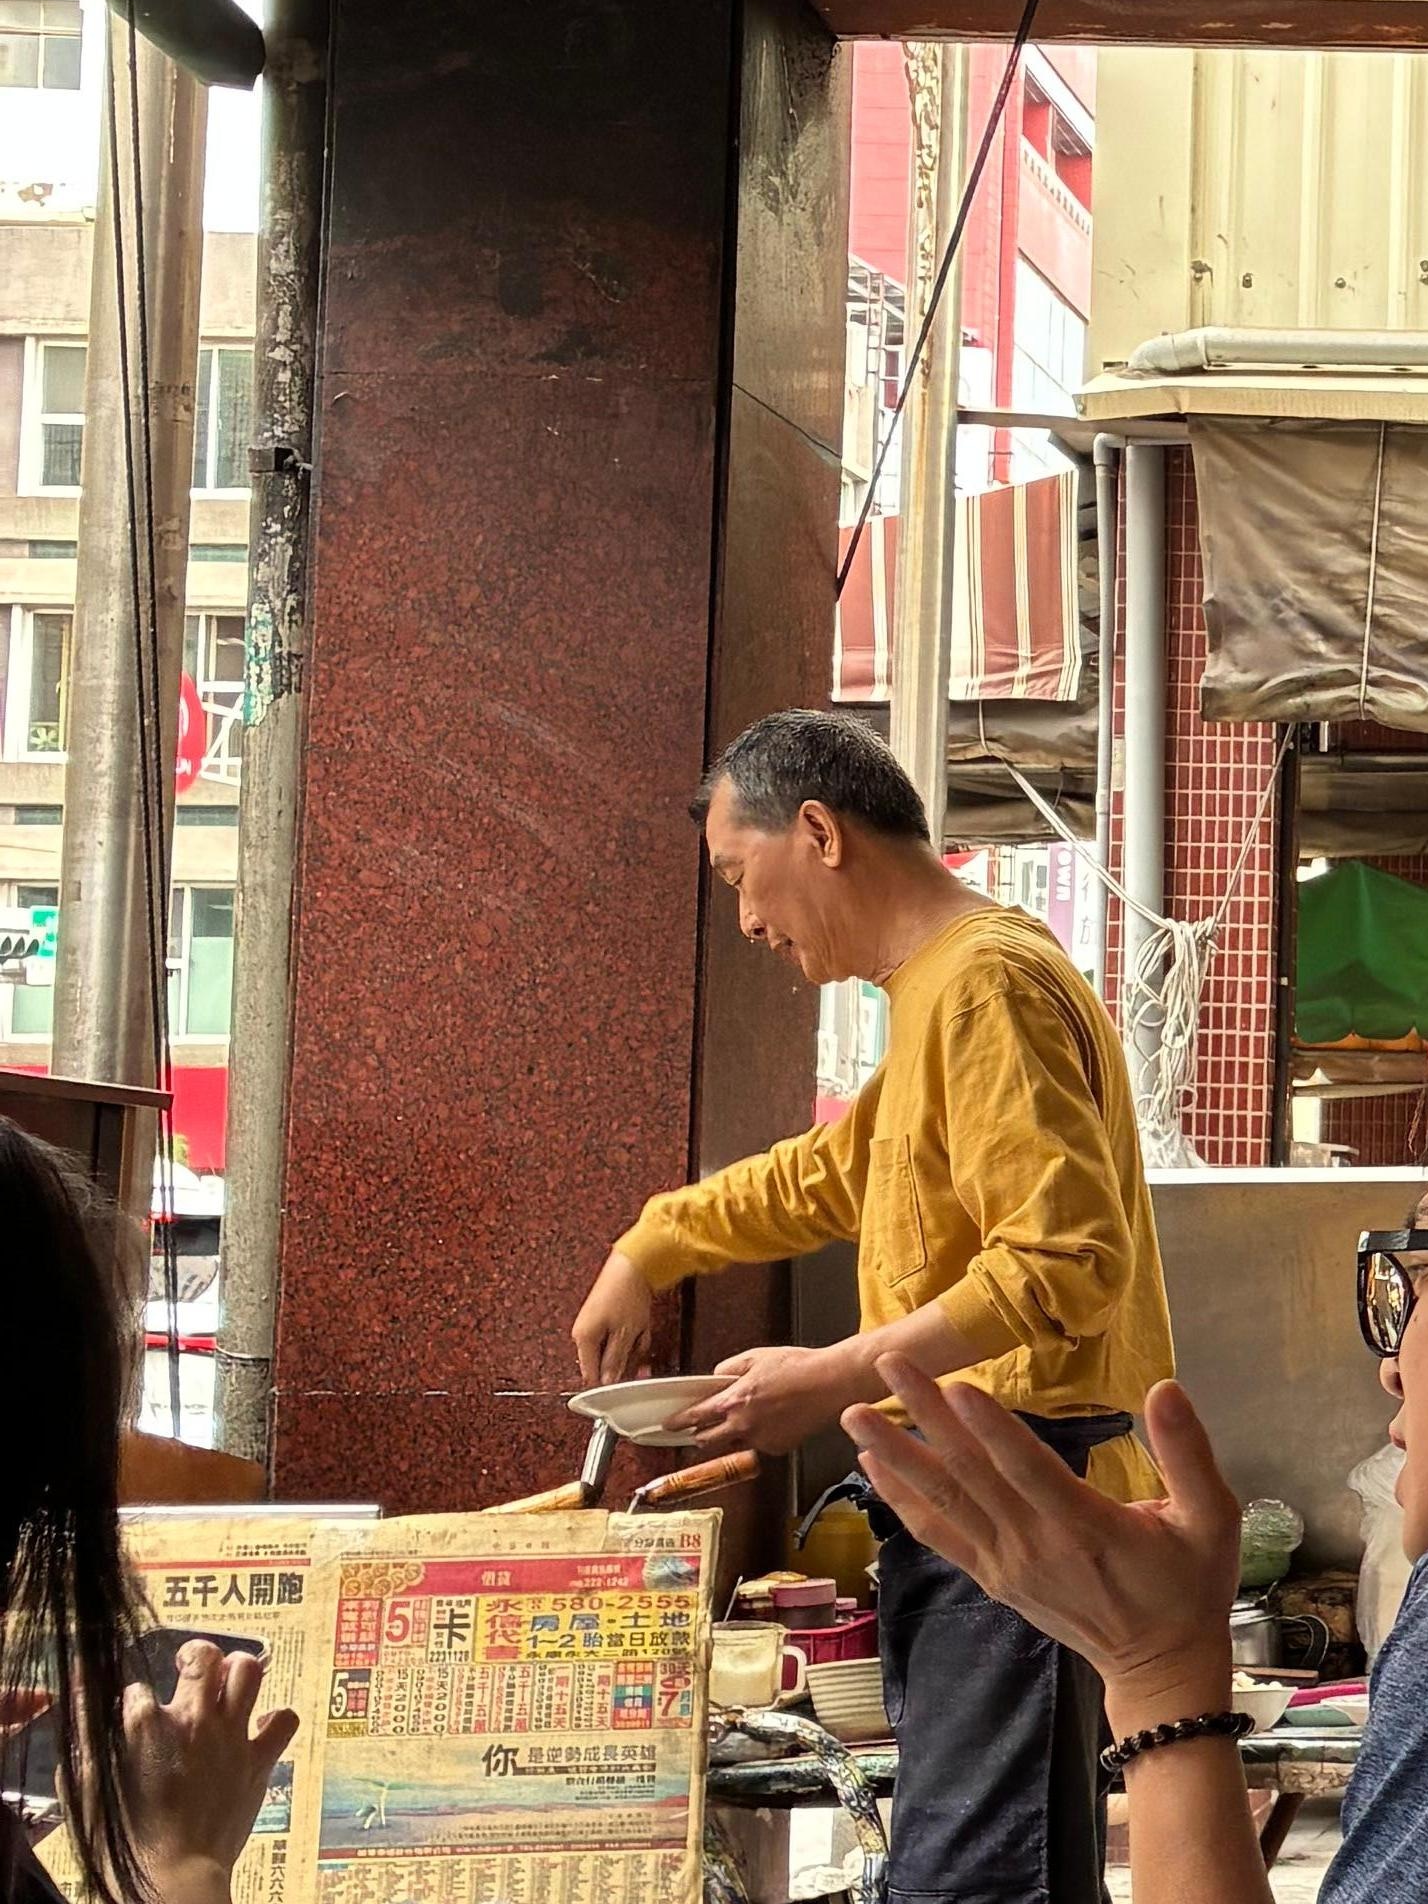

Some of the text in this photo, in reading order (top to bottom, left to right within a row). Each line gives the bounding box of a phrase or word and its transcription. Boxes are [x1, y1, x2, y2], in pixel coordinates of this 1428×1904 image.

[680, 1534, 701, 1548] B8
[163, 1572, 305, 1608] 五千人開跑
[552, 1596, 691, 1611] 580-2555
[433, 1609, 472, 1650] 卡
[482, 1744, 520, 1777] 你
[528, 1744, 657, 1764] 是逆勢成長英雄
